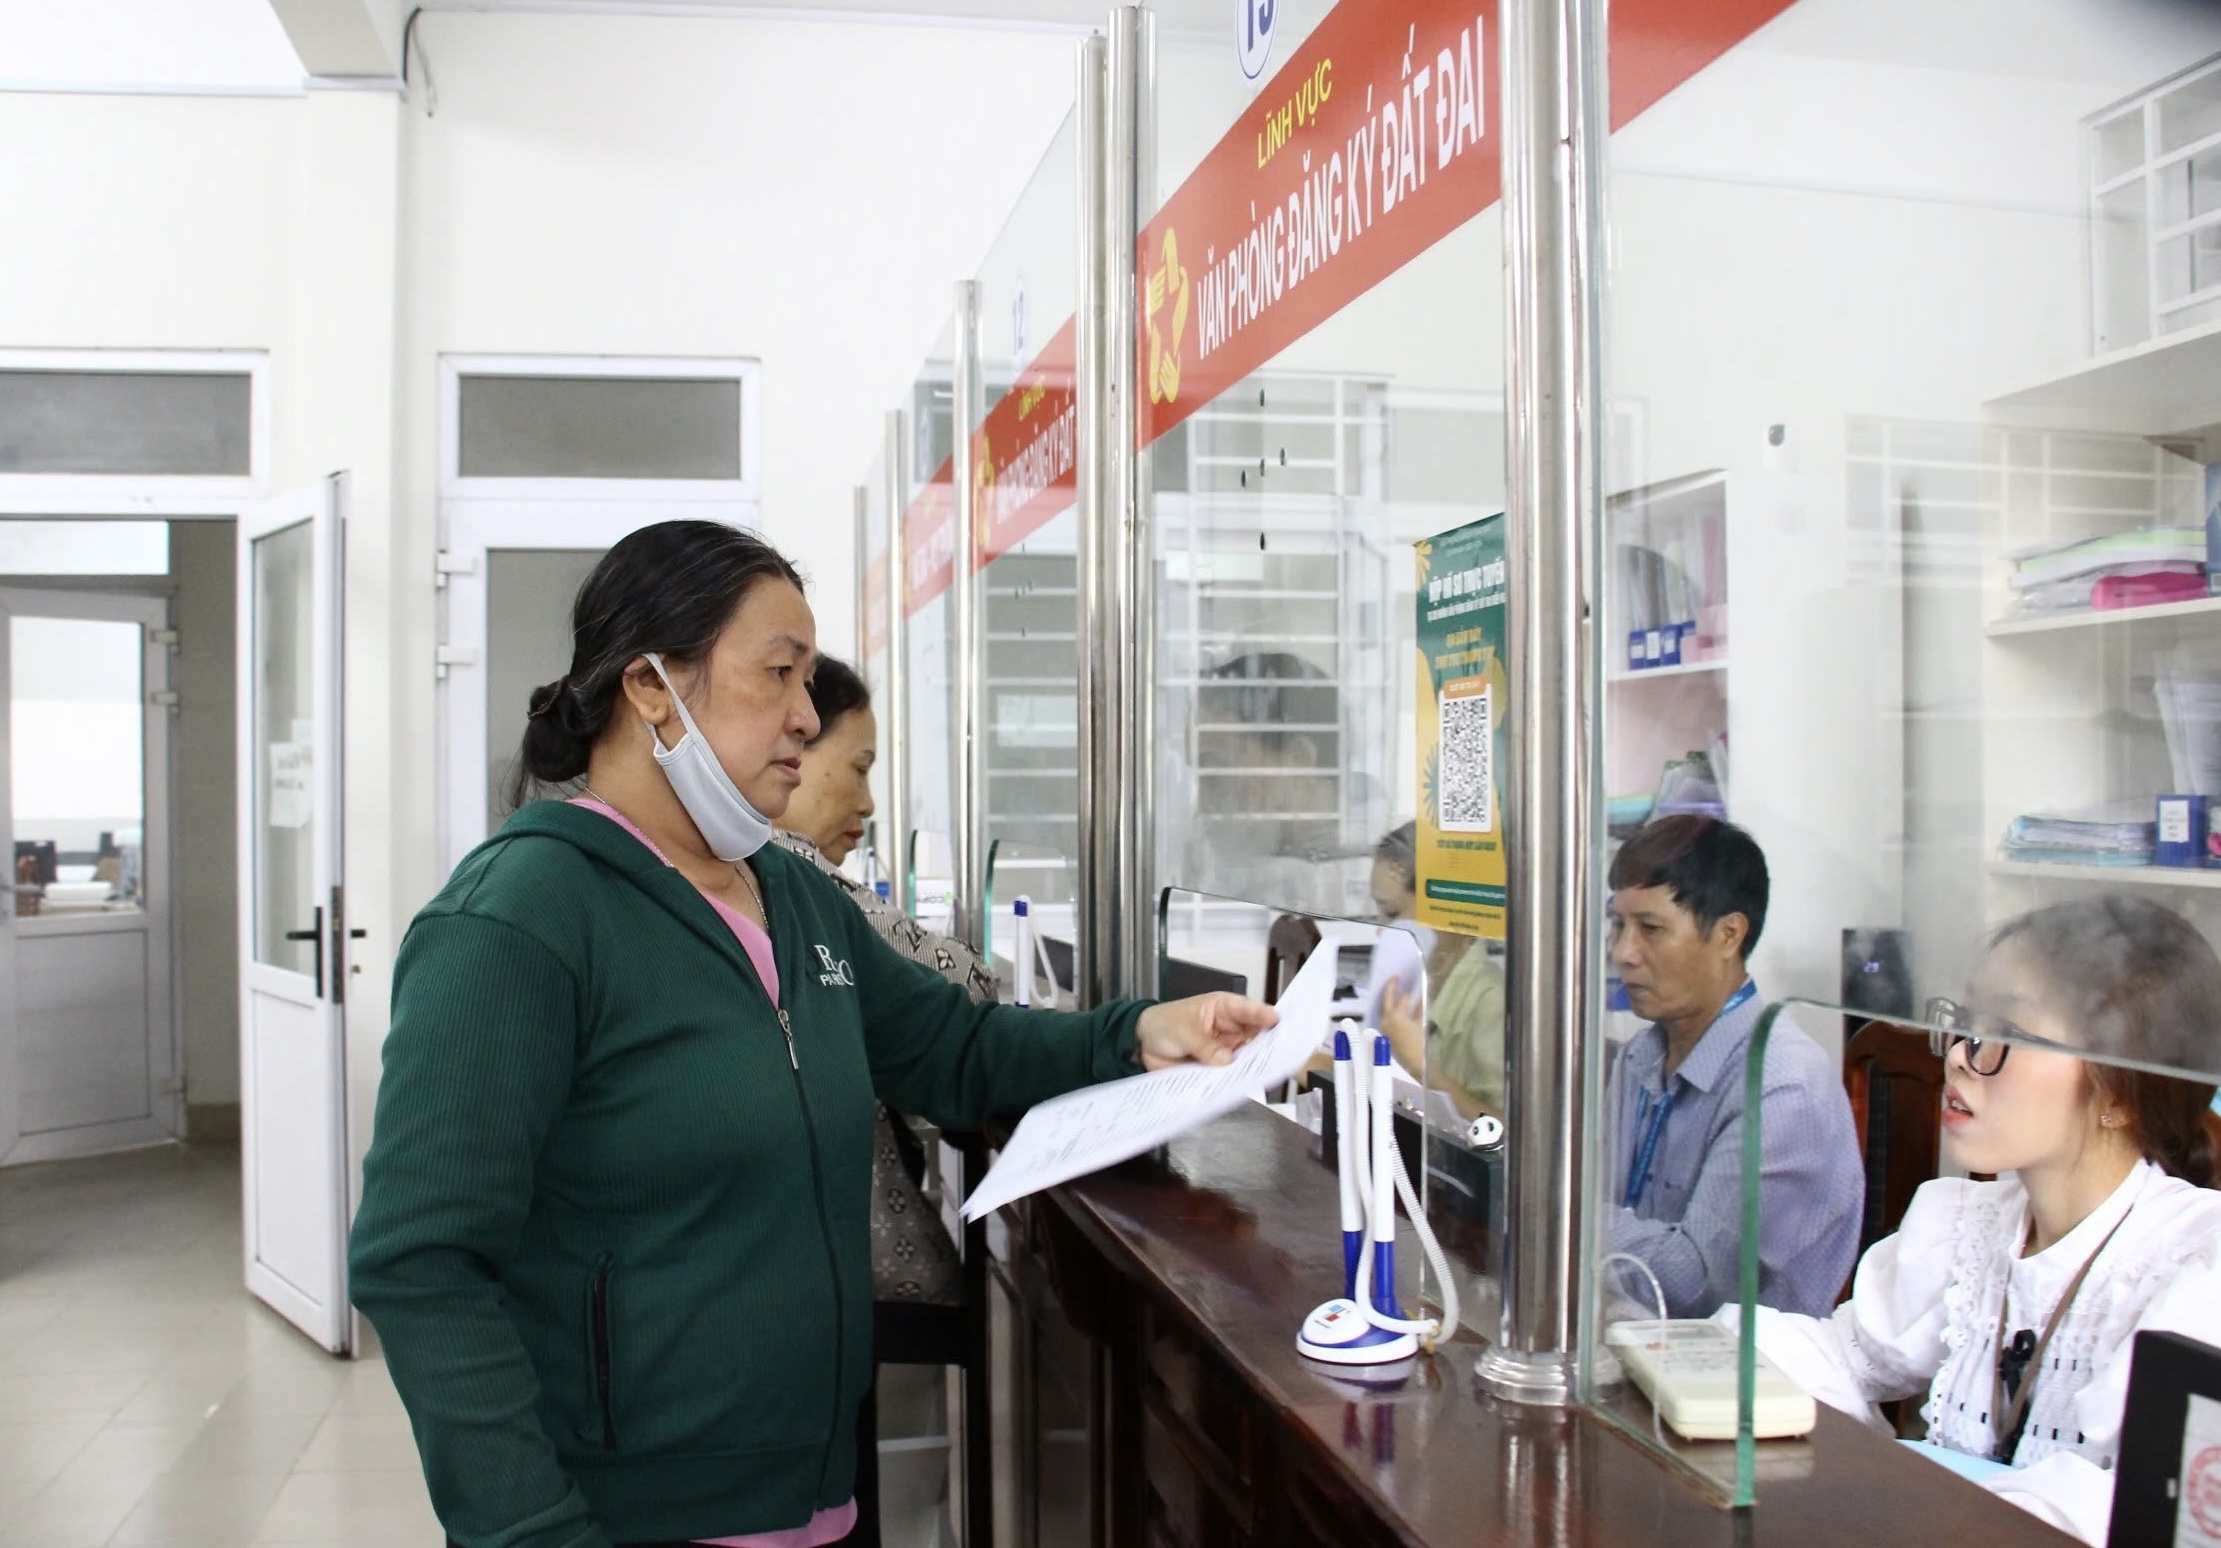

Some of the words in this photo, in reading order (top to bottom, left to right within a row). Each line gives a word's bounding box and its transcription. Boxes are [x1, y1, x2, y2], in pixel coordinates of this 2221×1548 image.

[1197, 244, 1226, 360] VĂN
[1228, 200, 1284, 338] PHÒNG
[1288, 149, 1343, 290] ĐĂNG
[1347, 83, 1377, 243] KÝ
[1381, 22, 1431, 214] ĐẤT
[1436, 14, 1486, 171] ĐAI
[1258, 99, 1292, 169] LĨNH
[1296, 58, 1332, 127] VỰC
